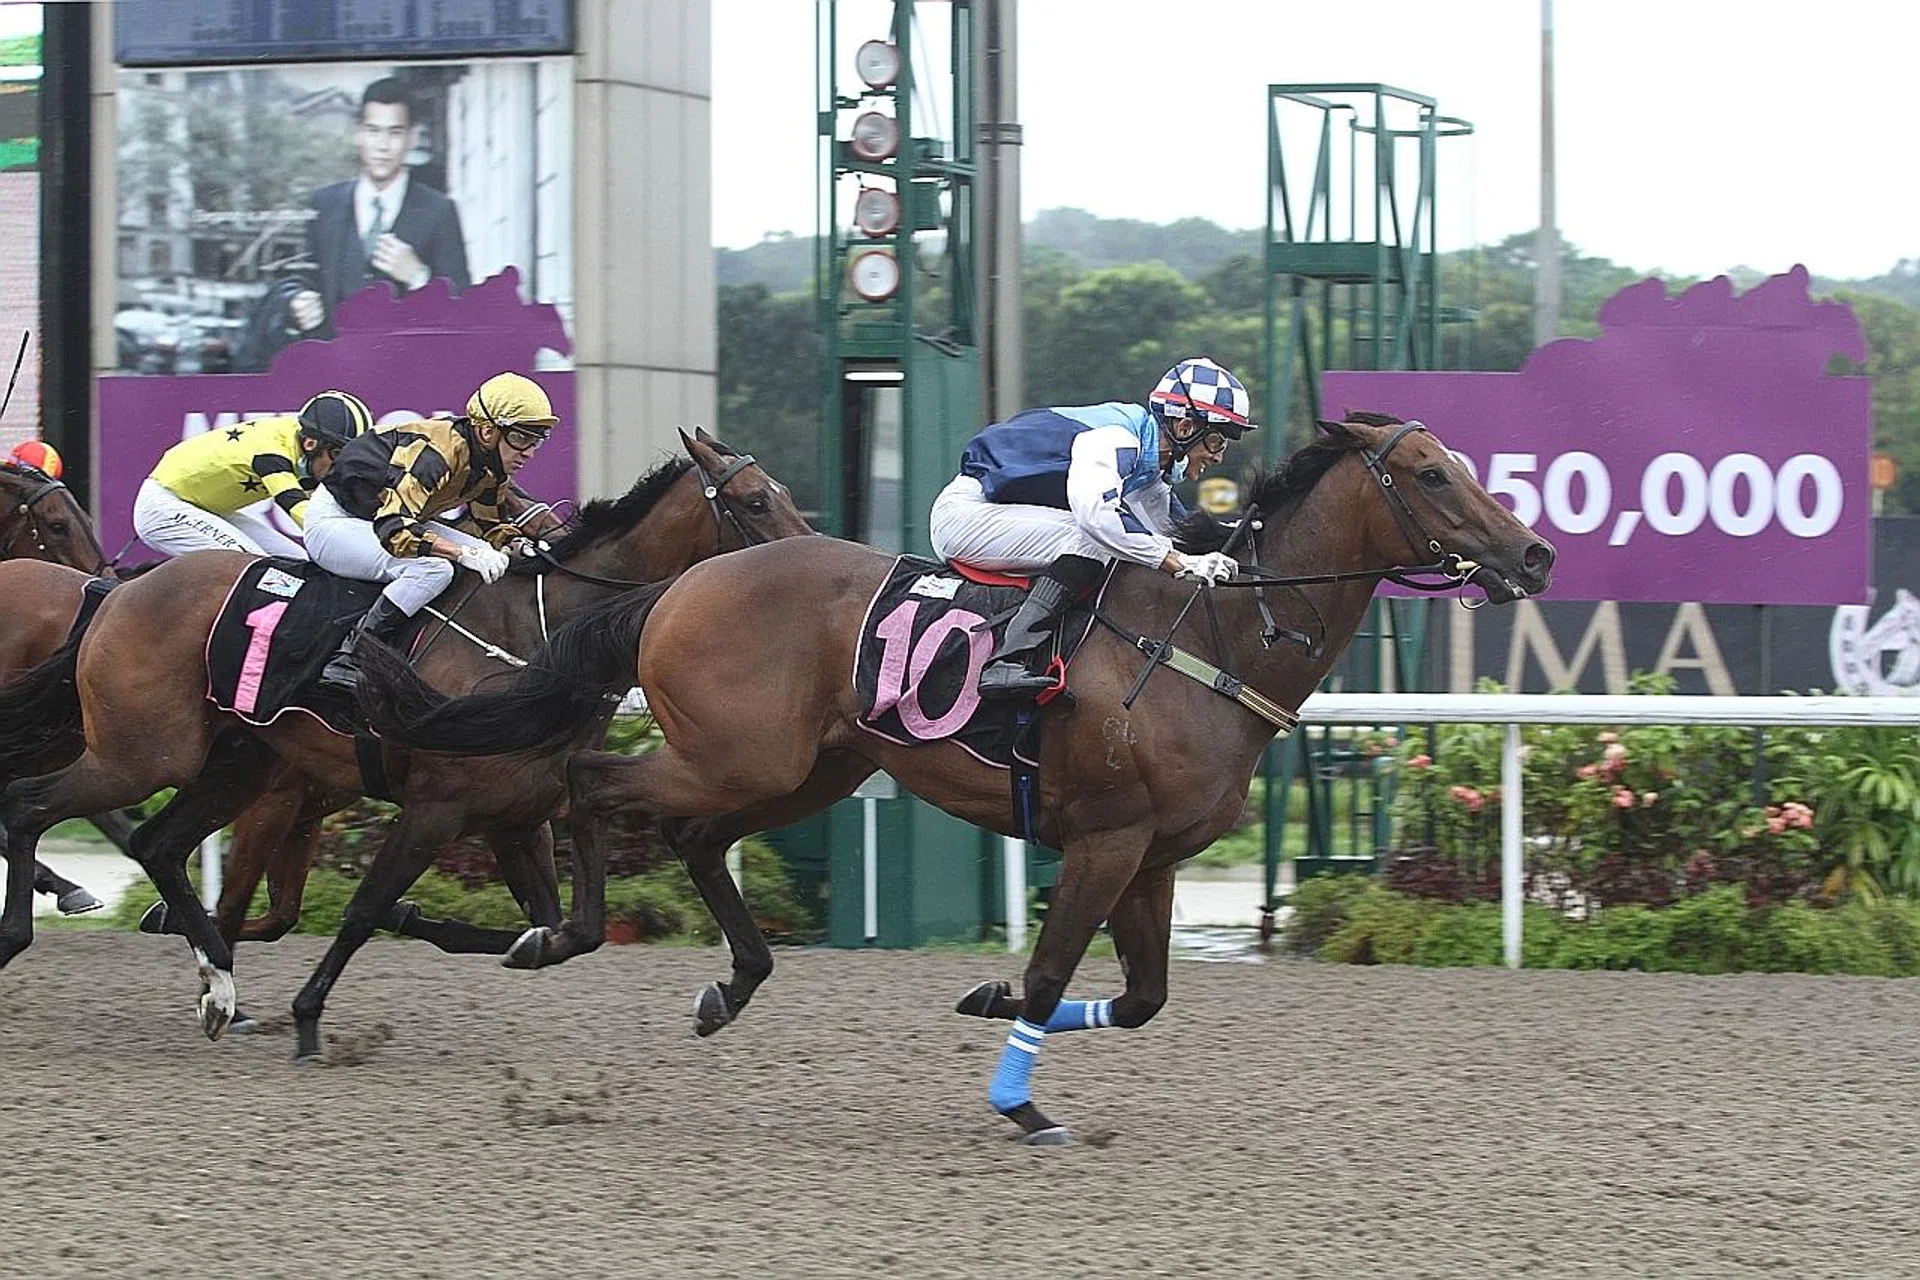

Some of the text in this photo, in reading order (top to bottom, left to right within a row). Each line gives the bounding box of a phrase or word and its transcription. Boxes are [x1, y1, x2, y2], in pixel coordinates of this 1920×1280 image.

[1451, 451, 1843, 546] 50,000
[234, 600, 289, 713] 1
[867, 600, 994, 740] 10
